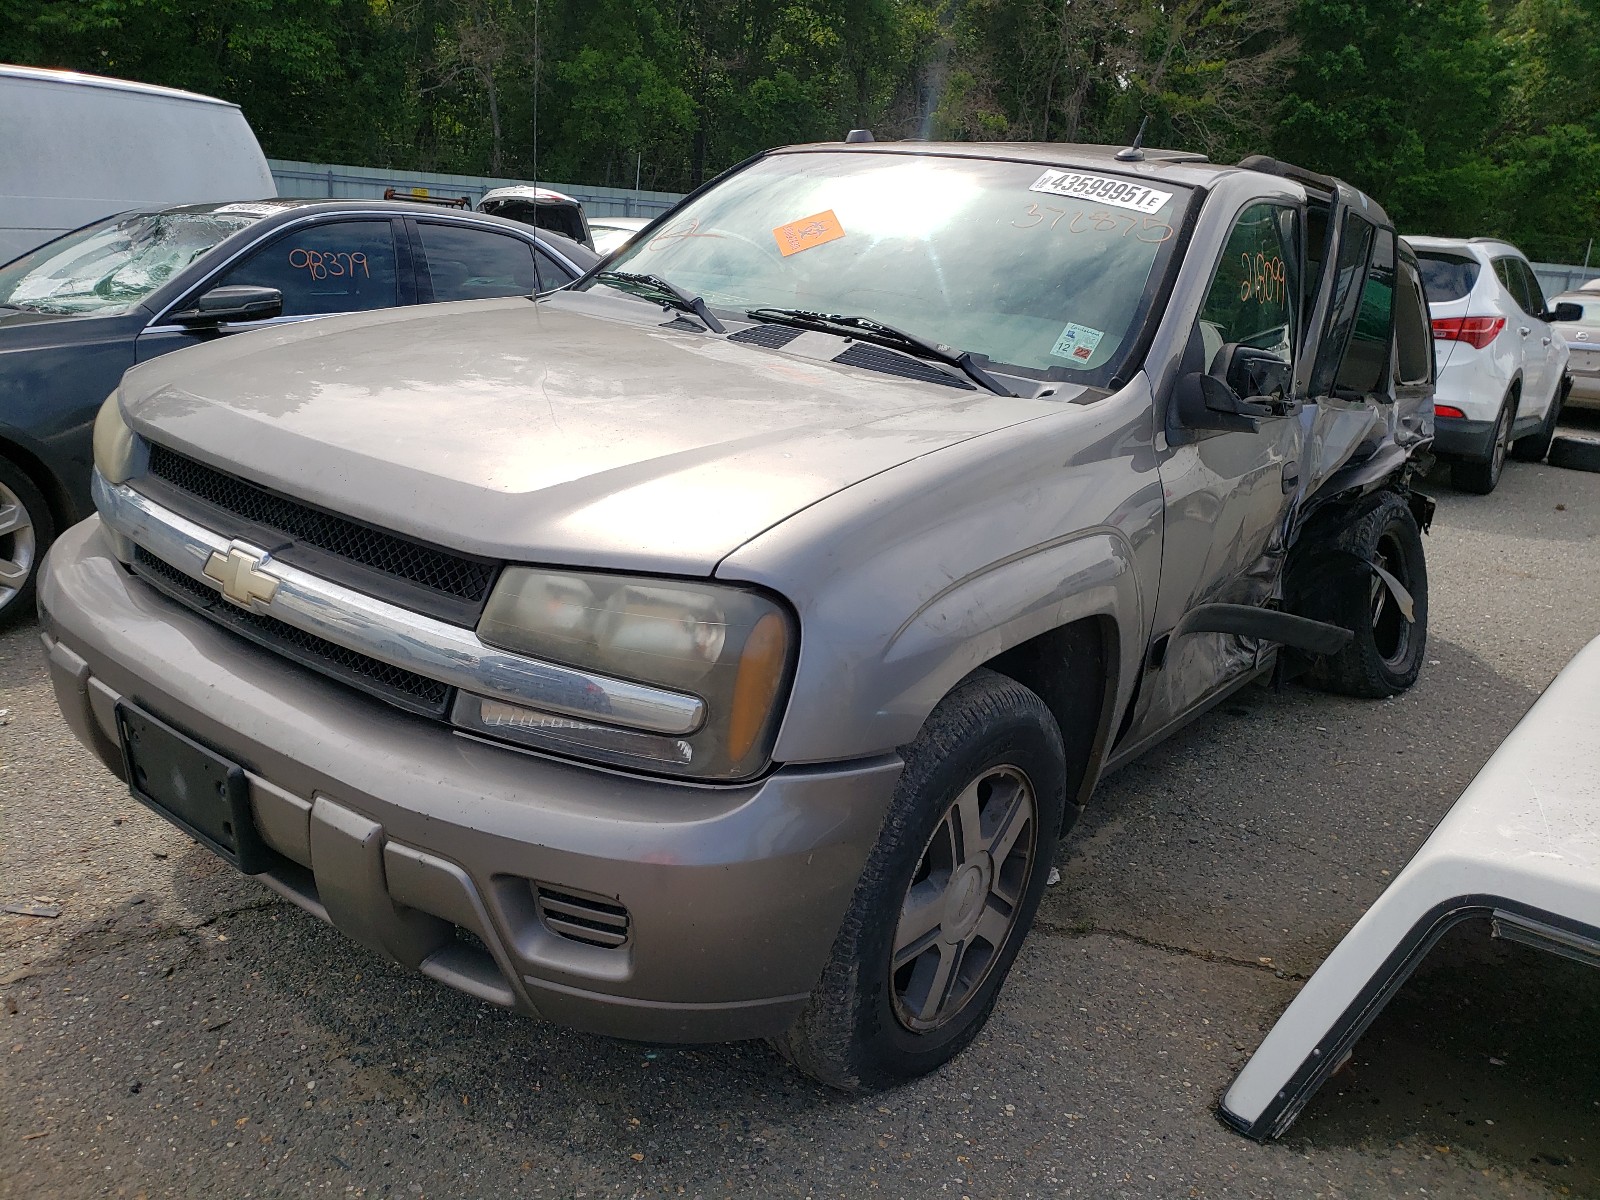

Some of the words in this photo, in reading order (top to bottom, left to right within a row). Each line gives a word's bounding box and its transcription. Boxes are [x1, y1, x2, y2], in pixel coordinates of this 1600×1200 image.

[1051, 174, 1152, 206] 43599951
[1146, 197, 1160, 207] E
[289, 248, 370, 281] 98379
[1058, 342, 1071, 352] 12
